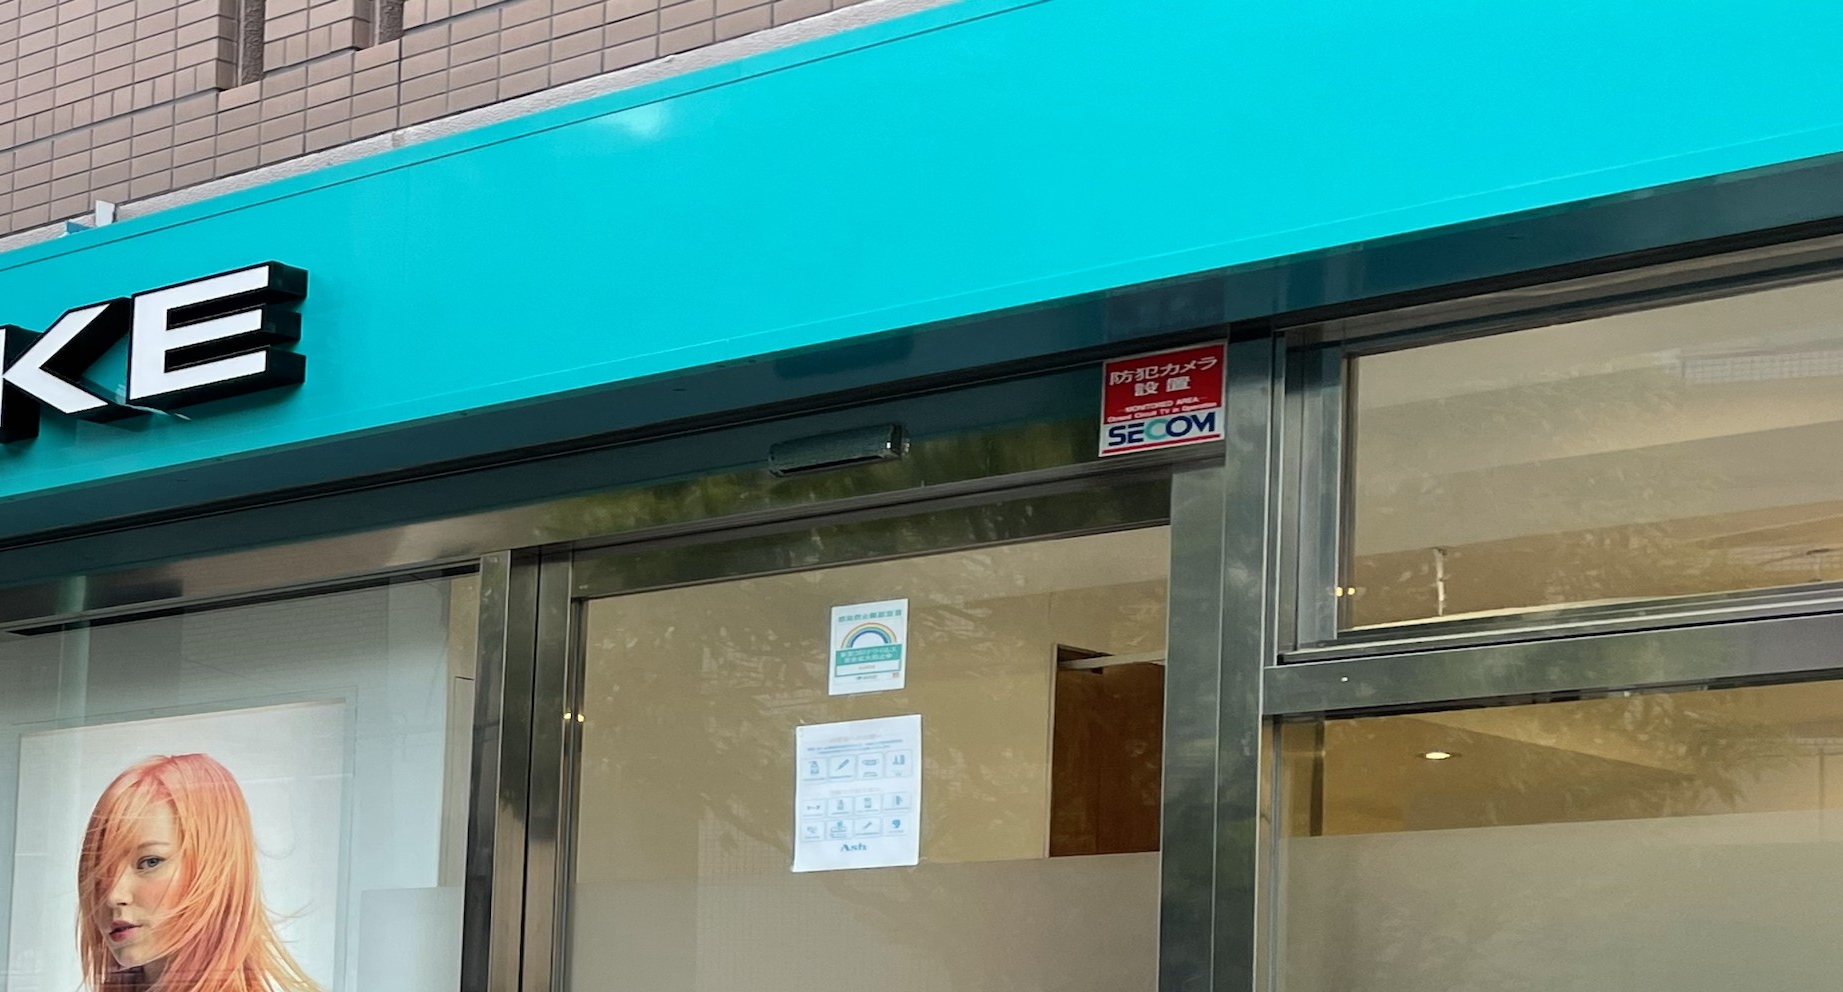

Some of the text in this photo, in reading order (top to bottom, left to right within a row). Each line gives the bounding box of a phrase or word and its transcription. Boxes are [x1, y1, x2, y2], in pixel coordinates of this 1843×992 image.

[1109, 356, 1218, 386] 防犯カメラ
[1108, 411, 1216, 447] SECOM
[840, 843, 867, 852] Ash
